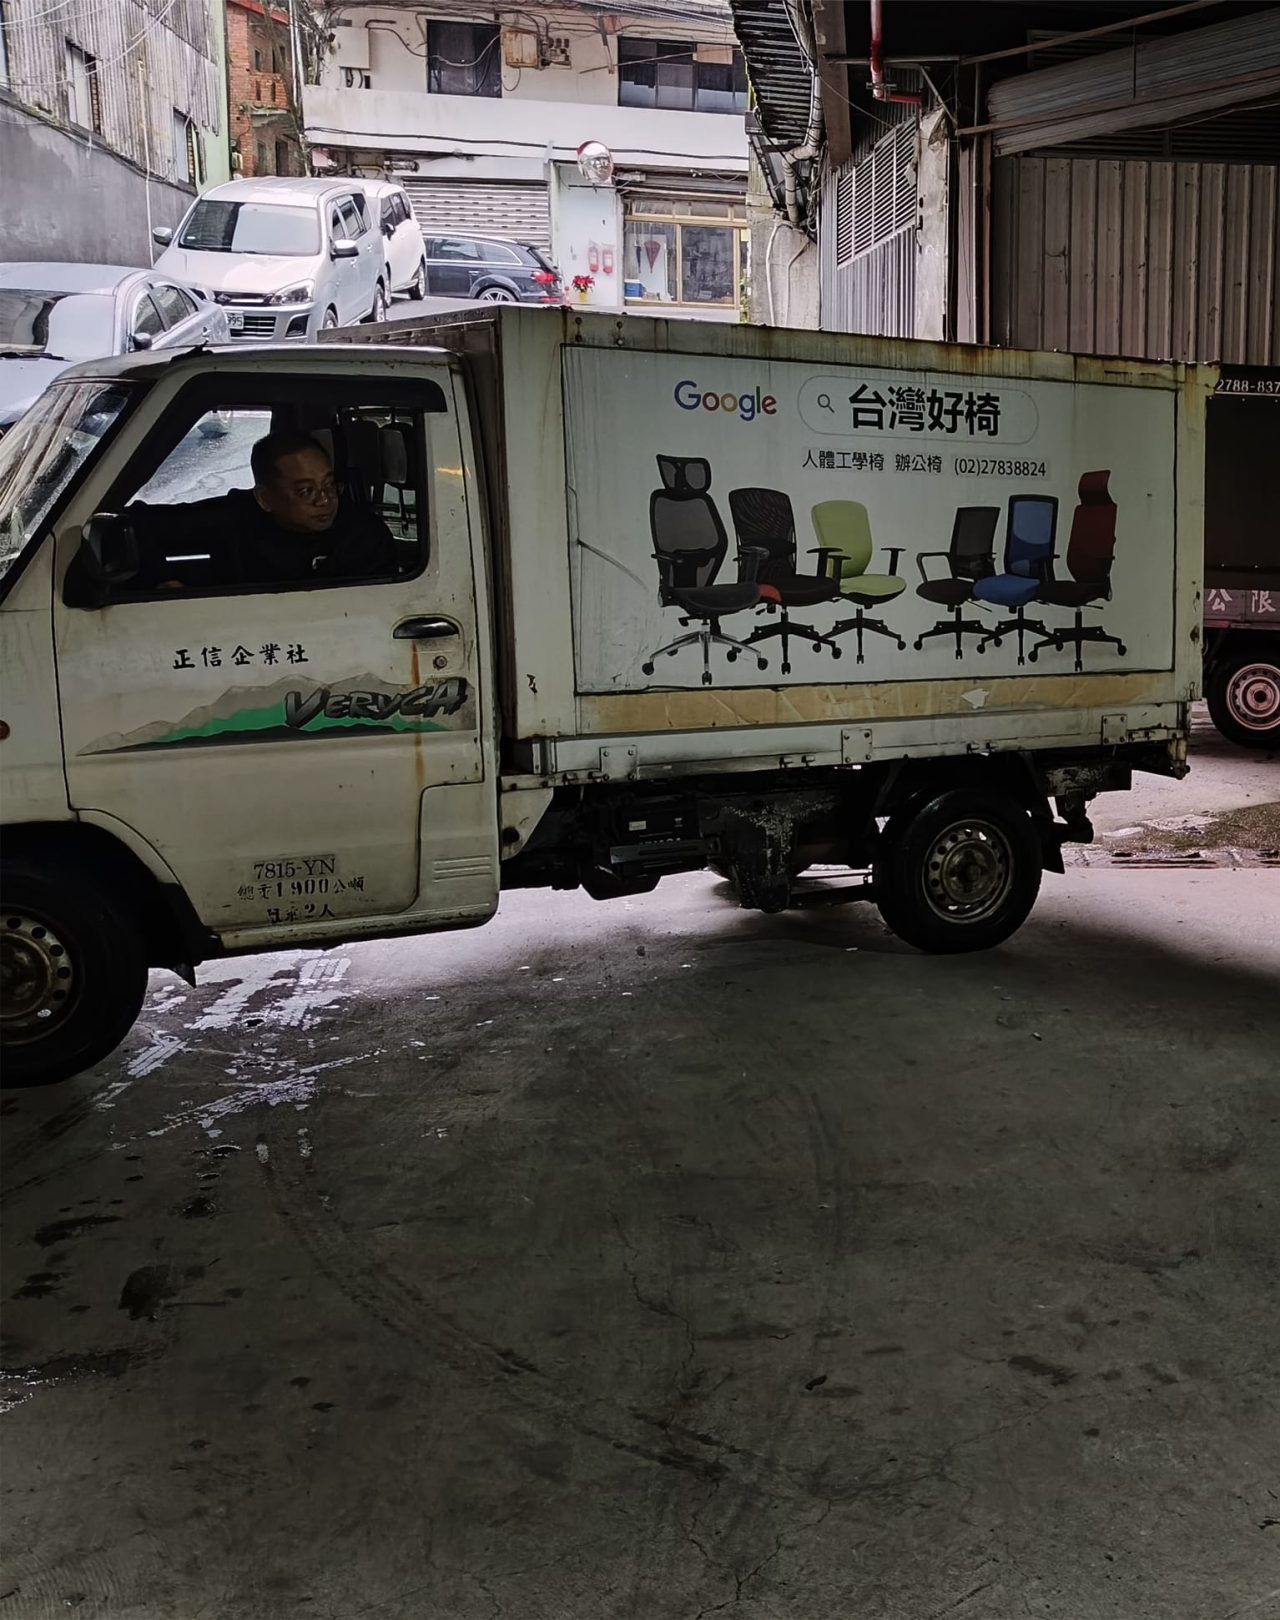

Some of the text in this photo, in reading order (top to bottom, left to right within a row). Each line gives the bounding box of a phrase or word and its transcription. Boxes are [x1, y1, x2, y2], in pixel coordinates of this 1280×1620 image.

[674, 380, 777, 421] Google
[849, 384, 1001, 436] 台灣好椅
[802, 450, 1046, 477] 人體工學椅 辦公椅 (02)27838824
[173, 643, 309, 669] 正信企業社
[284, 677, 468, 728] VERYCA
[254, 858, 336, 880] 7815-YN
